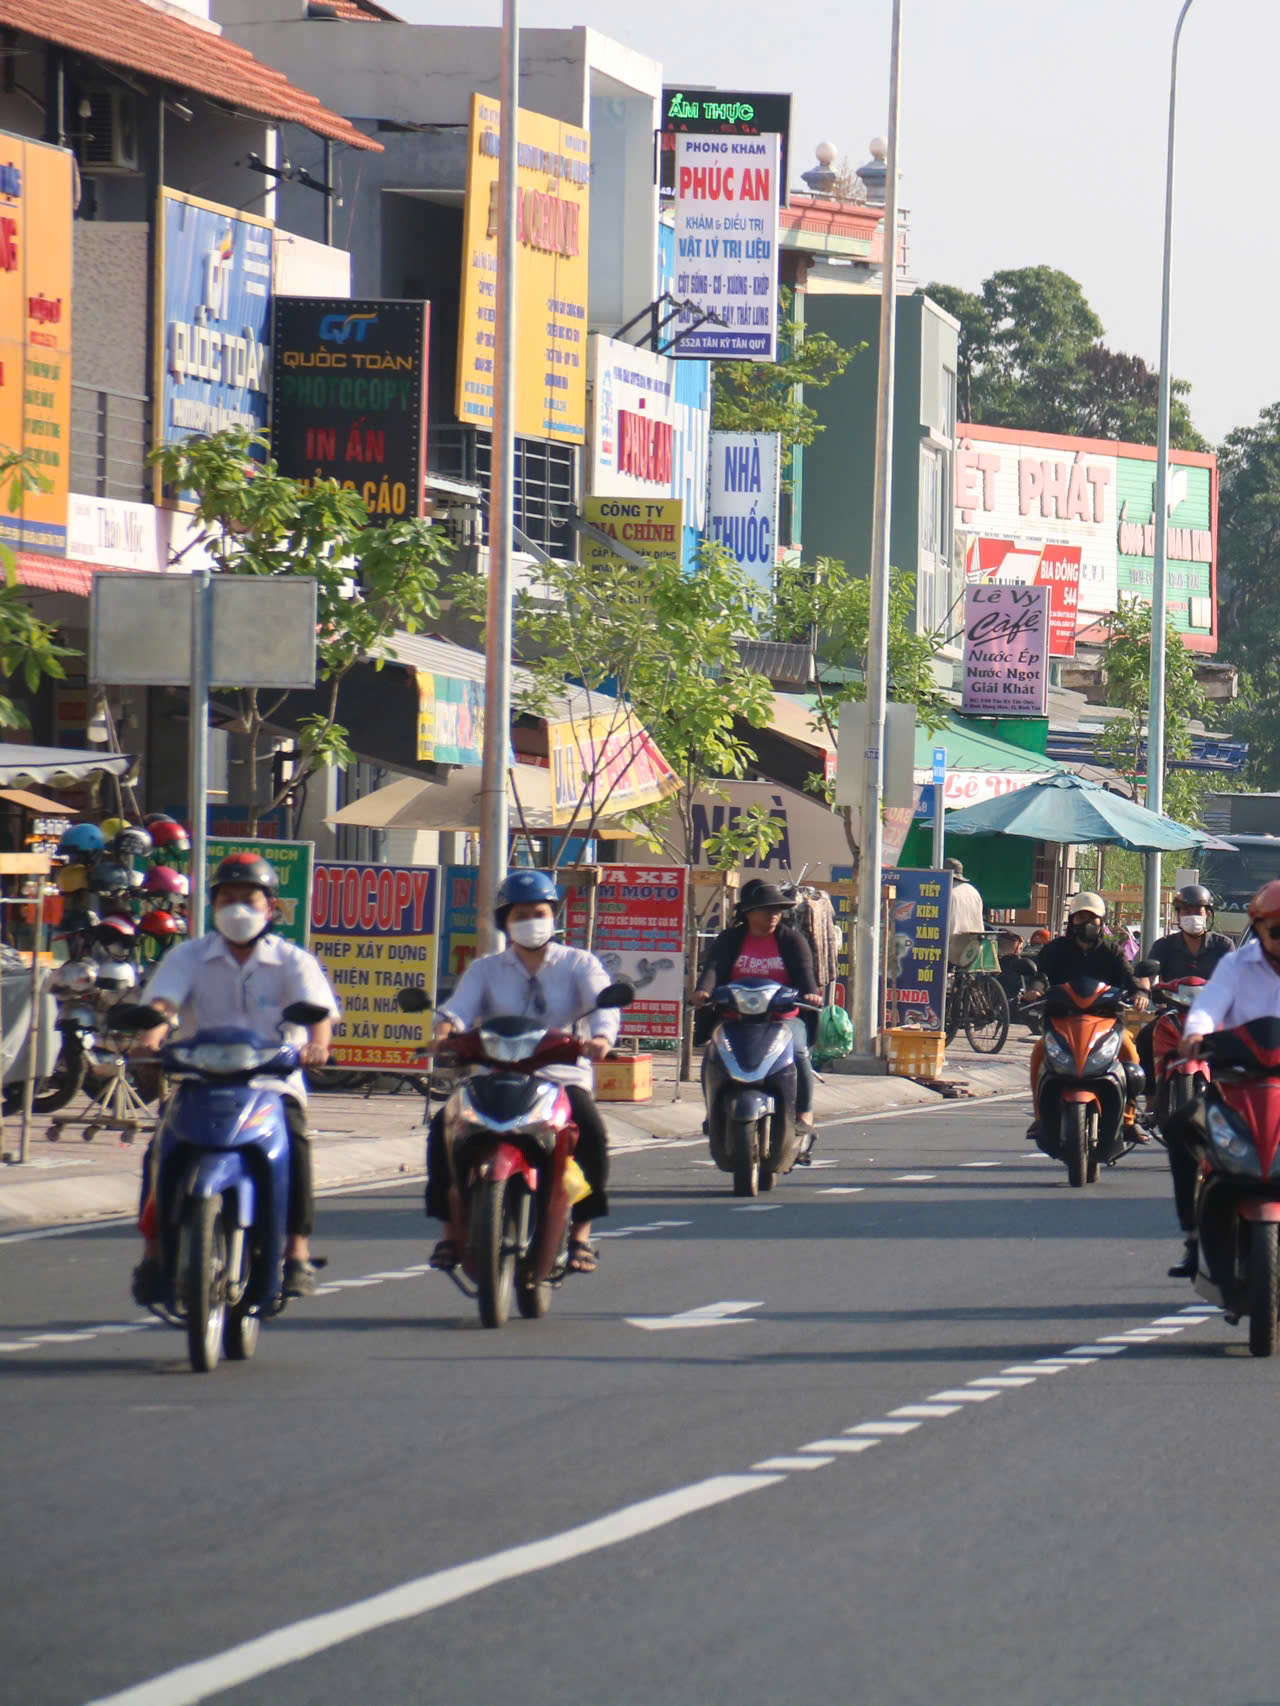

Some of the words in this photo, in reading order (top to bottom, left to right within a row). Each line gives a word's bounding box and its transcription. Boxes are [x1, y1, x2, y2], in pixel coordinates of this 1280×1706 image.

[679, 159, 735, 201] PHÚC
[739, 167, 770, 201] AN
[678, 234, 702, 262] VẬT
[705, 235, 719, 258] LÝ
[722, 239, 743, 263] TRỊ
[745, 236, 771, 264] LIỆU
[306, 427, 337, 461] IN
[344, 416, 385, 463] ẤN
[724, 438, 762, 493] NHÀ
[1018, 451, 1111, 524] PHÁT
[600, 500, 641, 517] CÔNG
[645, 504, 664, 518] TY
[622, 519, 676, 542] CHÍNH
[712, 500, 770, 564] THUỐC
[972, 589, 1002, 604] Lê
[1011, 590, 1041, 608] Vy
[969, 649, 1013, 663] Nước
[1018, 648, 1040, 666] Ép
[1007, 667, 1041, 682] Ngọt
[1003, 682, 1036, 695] Khát
[944, 773, 979, 799] Lê
[635, 871, 679, 885] XE
[312, 865, 429, 932] OTOCOPY
[622, 885, 680, 901] MOTO
[315, 939, 351, 958] PHÉP
[356, 939, 385, 961] XÂY
[388, 945, 428, 964] DỰNG
[333, 966, 369, 989] HIỆN
[374, 971, 425, 991] TRẠNG
[351, 1020, 380, 1038] XÂY
[383, 1023, 423, 1043] DỰNG
